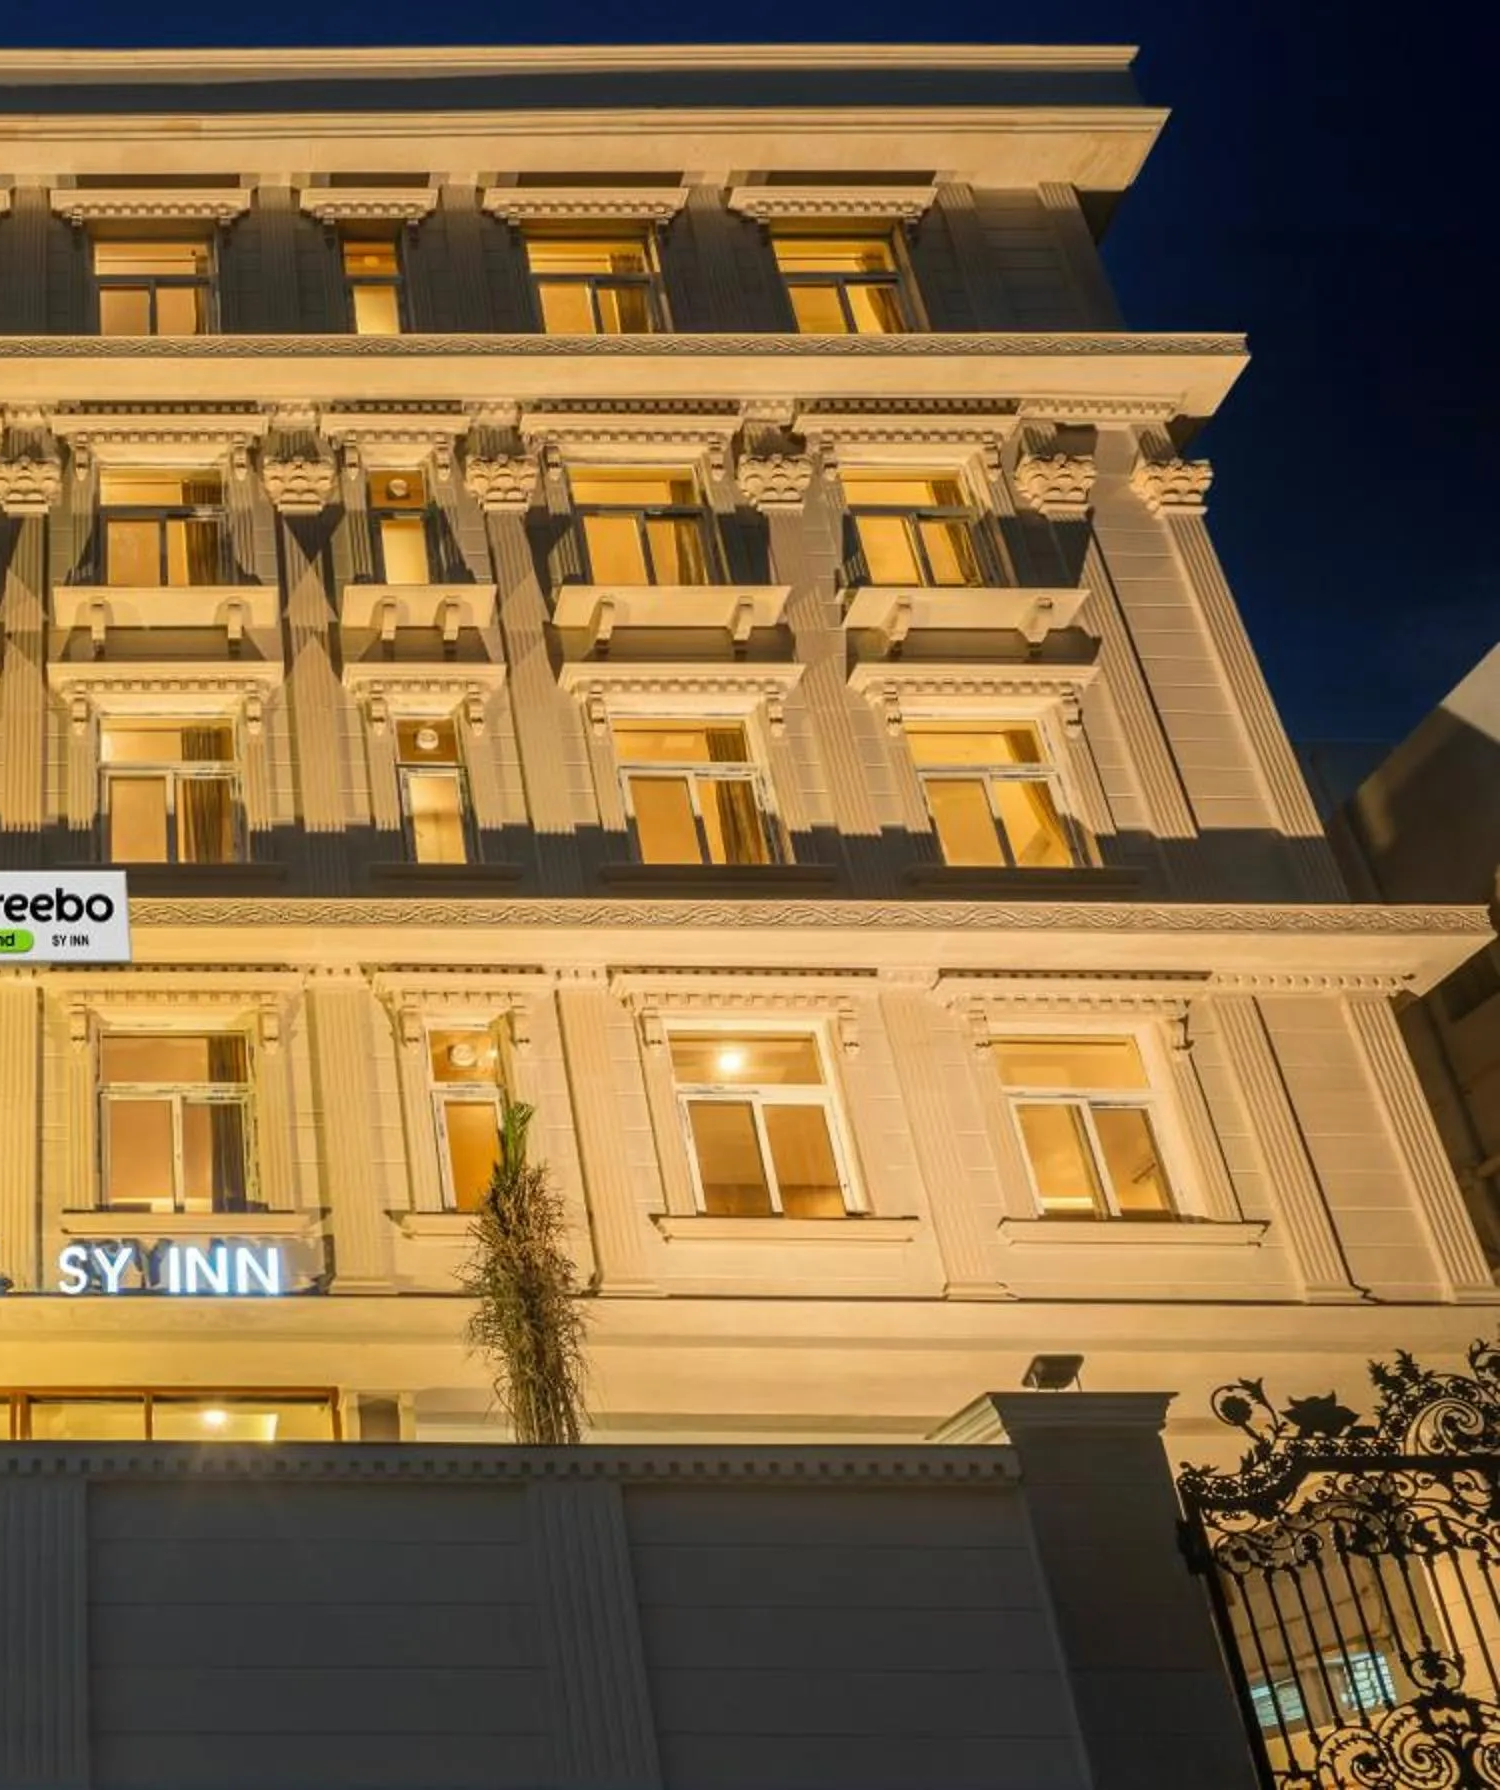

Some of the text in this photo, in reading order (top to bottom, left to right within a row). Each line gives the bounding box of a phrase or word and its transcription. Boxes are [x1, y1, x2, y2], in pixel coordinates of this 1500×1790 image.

[52, 935, 89, 947] SY INN
[58, 1246, 133, 1295] SY
[168, 1246, 280, 1295] INN
